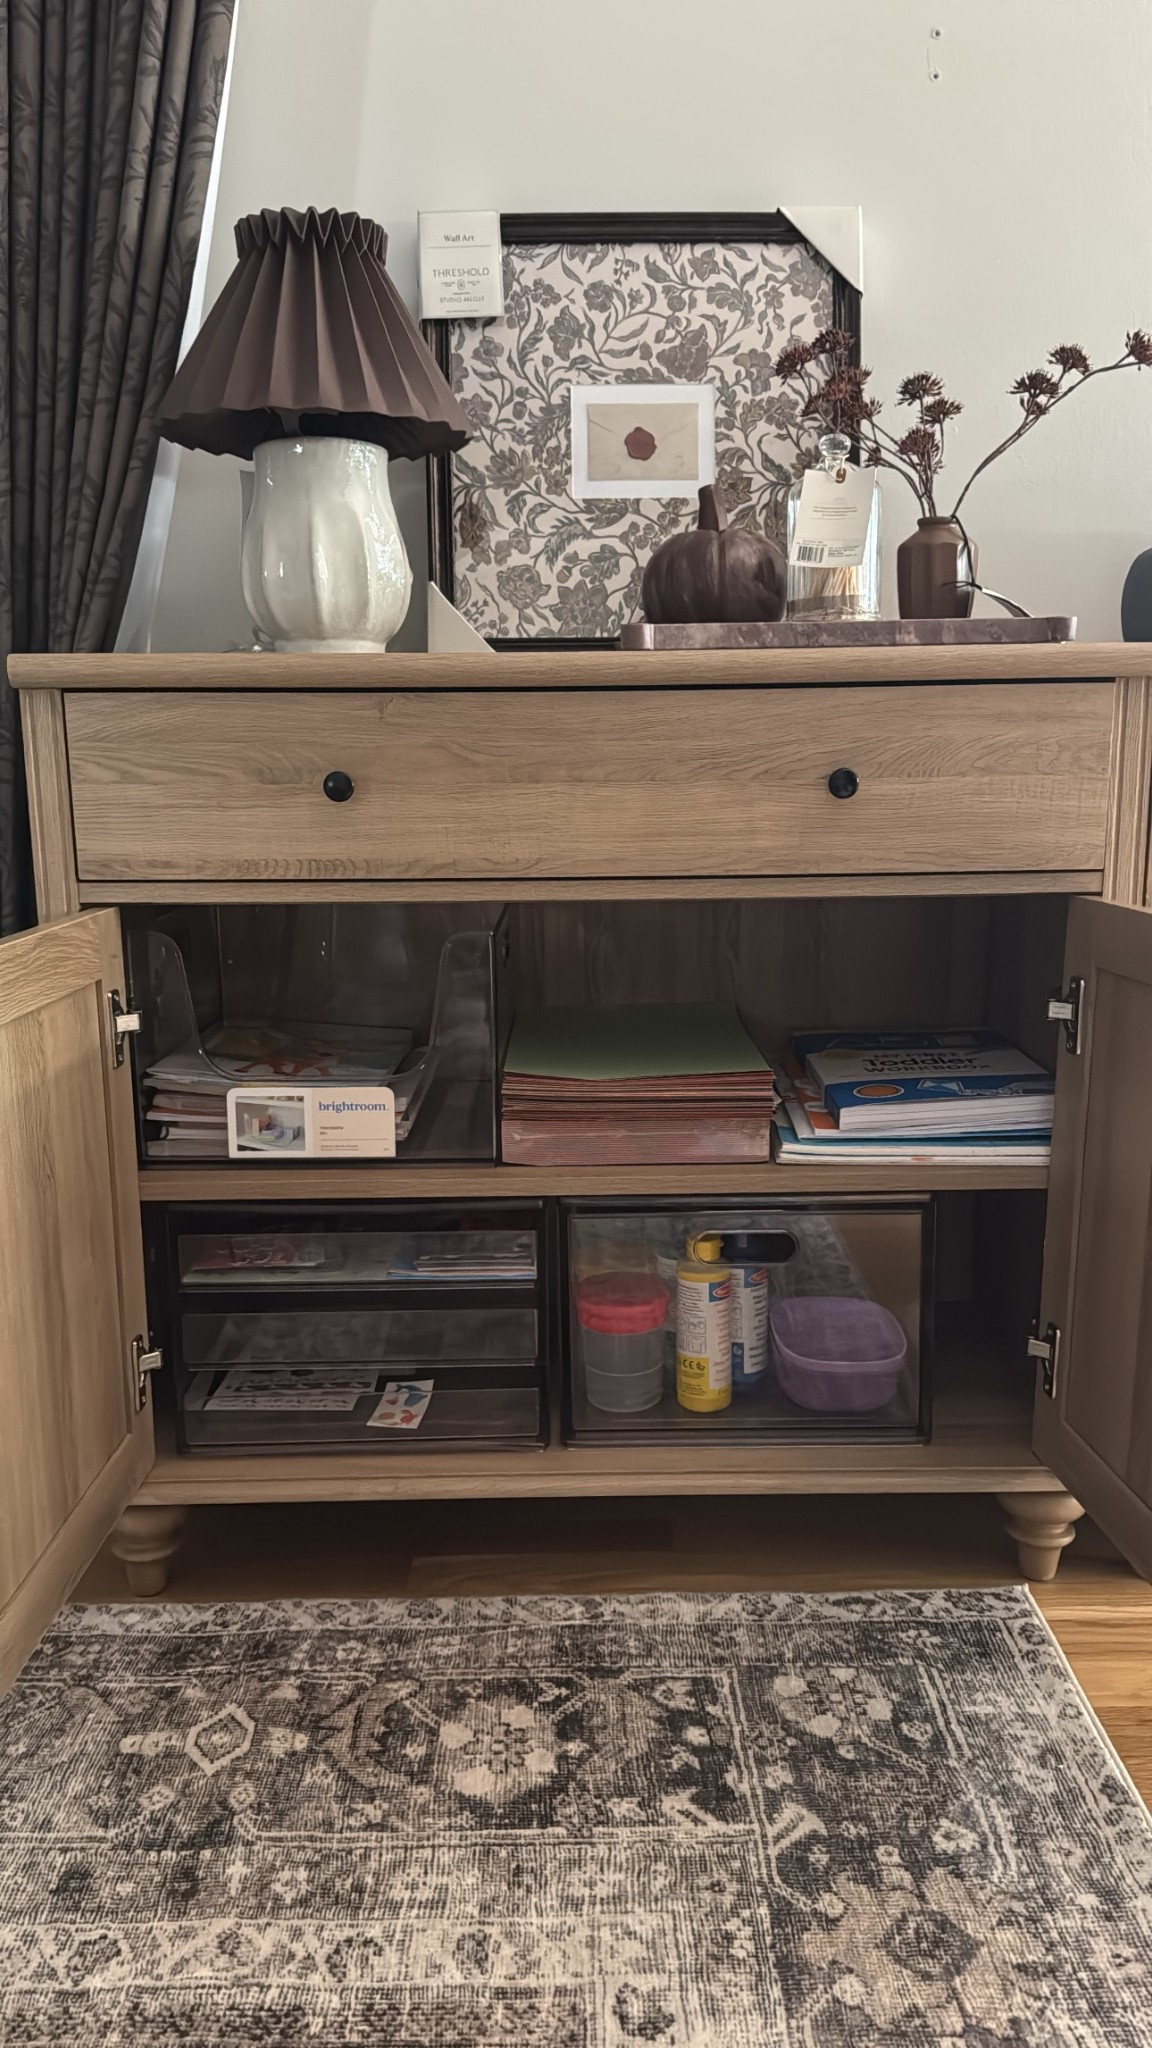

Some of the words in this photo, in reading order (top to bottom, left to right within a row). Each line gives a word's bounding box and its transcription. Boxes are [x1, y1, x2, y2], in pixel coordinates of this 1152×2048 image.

[432, 267, 489, 278] THRESHOLD
[862, 1056, 978, 1067] Toddler
[864, 1064, 991, 1072] WORKBOOK
[319, 1101, 386, 1113] brightroom
